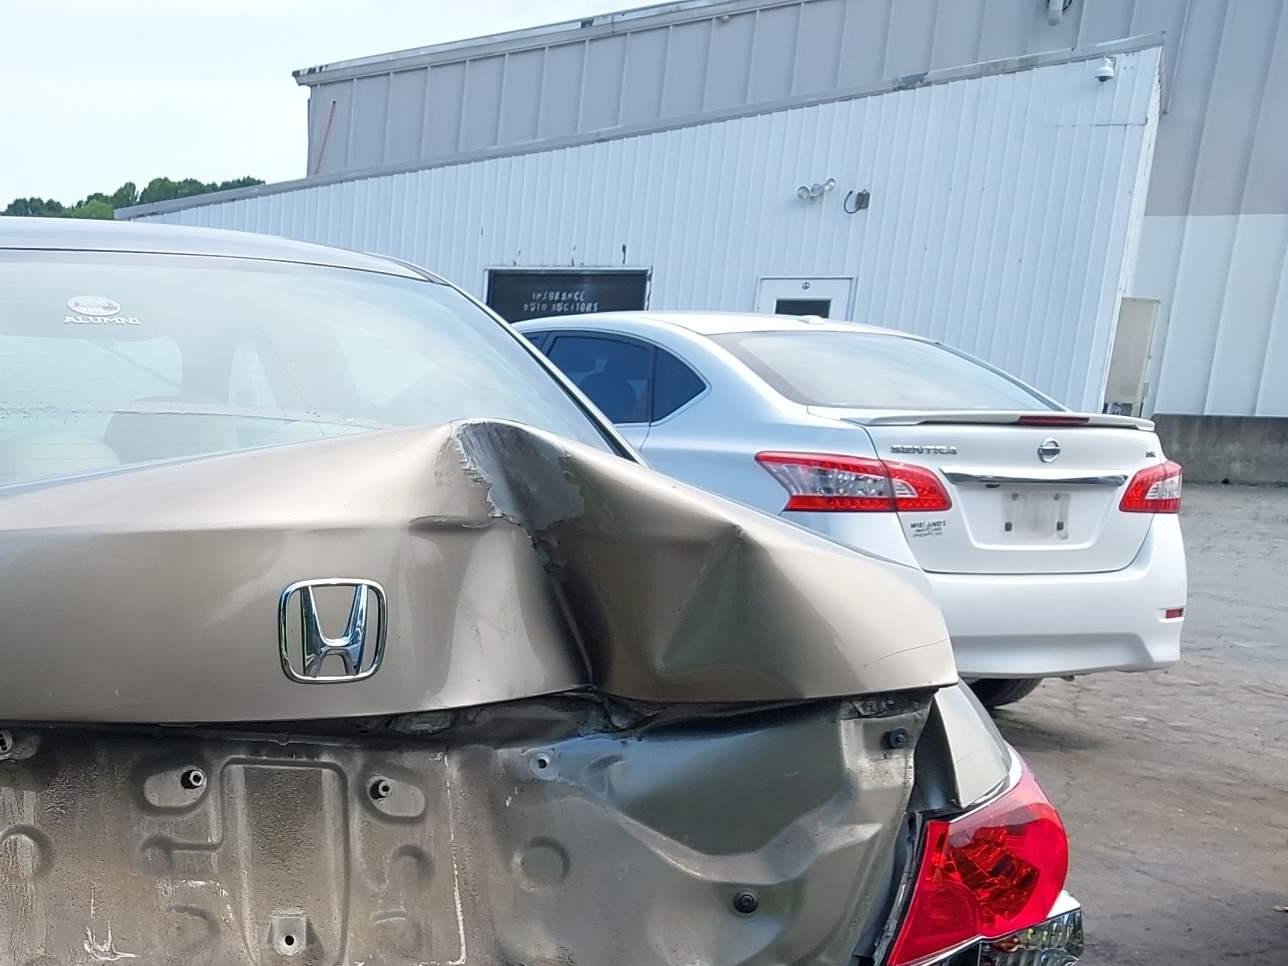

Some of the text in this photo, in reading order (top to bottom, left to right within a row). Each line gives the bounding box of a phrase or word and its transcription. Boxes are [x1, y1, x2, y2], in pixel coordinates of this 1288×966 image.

[532, 290, 585, 301] INSURANCE
[63, 316, 141, 326] ALUMNI
[890, 444, 958, 455] SENTRA
